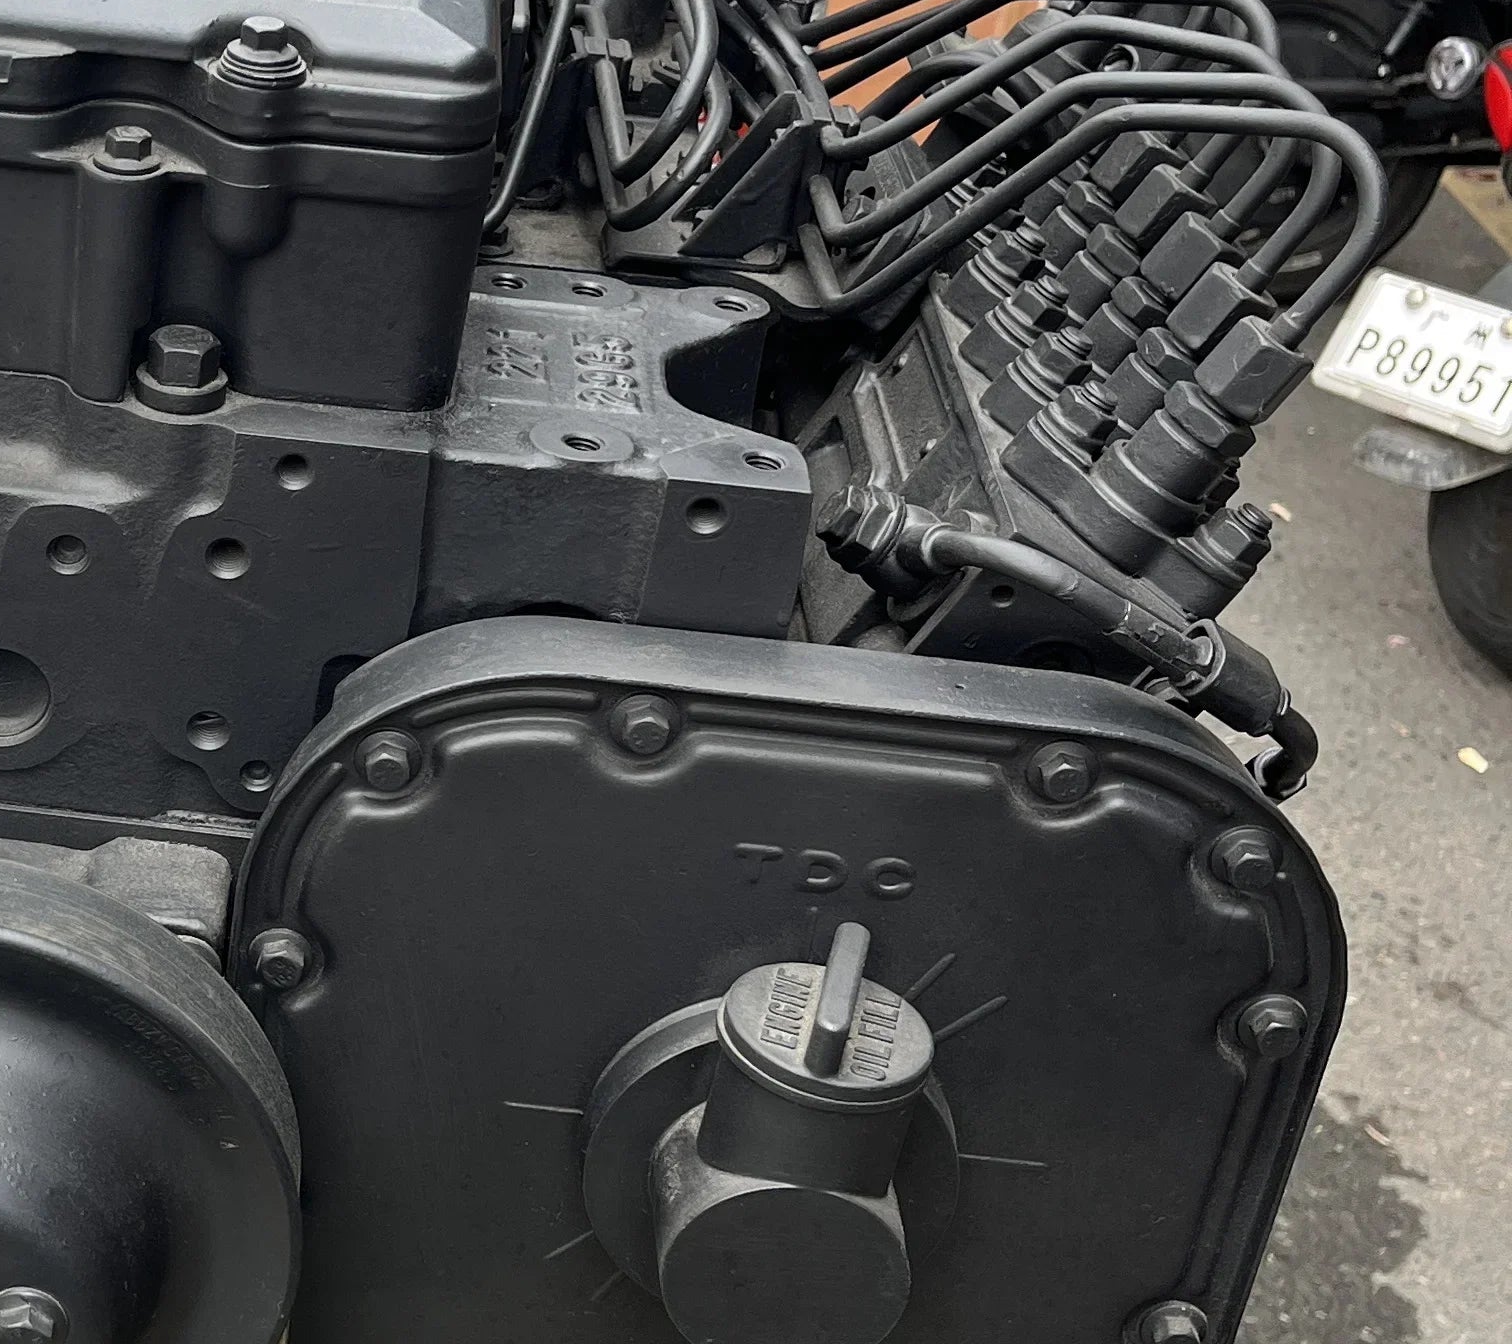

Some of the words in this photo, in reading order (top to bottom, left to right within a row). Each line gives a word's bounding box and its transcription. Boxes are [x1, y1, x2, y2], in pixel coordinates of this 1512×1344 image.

[734, 842, 917, 902] TDC
[759, 967, 814, 1050] ENGINE
[857, 996, 903, 1044] FILL
[849, 1046, 892, 1082] OIL
